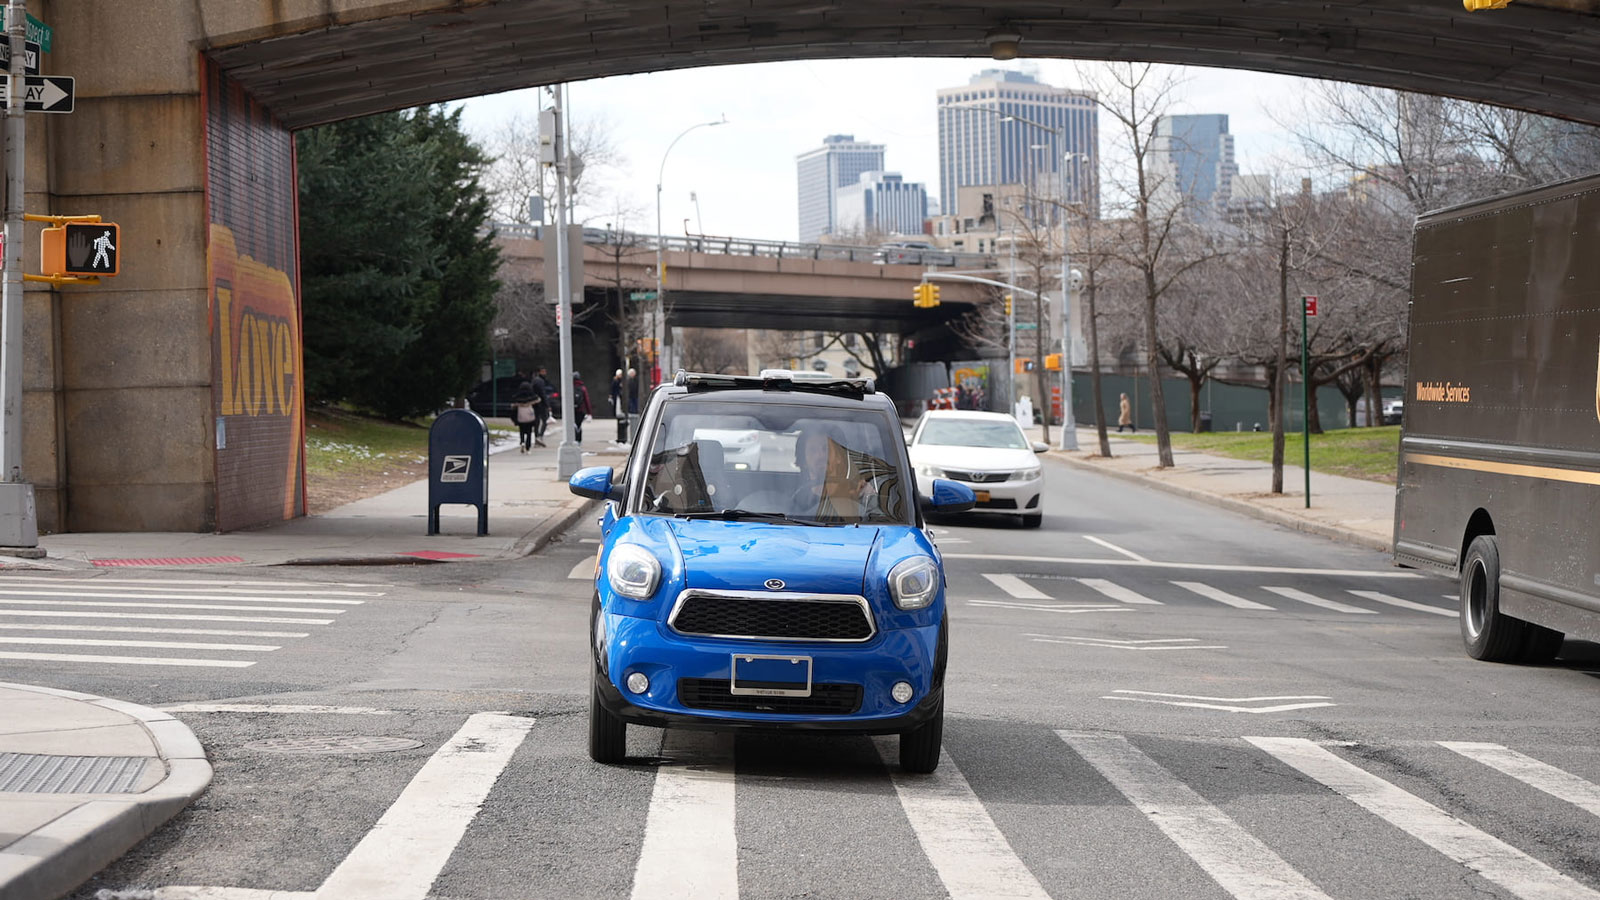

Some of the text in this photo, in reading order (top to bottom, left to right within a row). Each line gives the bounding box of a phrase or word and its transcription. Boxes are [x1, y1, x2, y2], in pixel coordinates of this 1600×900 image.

[25, 87, 45, 100] AY
[216, 284, 293, 417] Love
[1416, 381, 1470, 402] Worldwide Services
